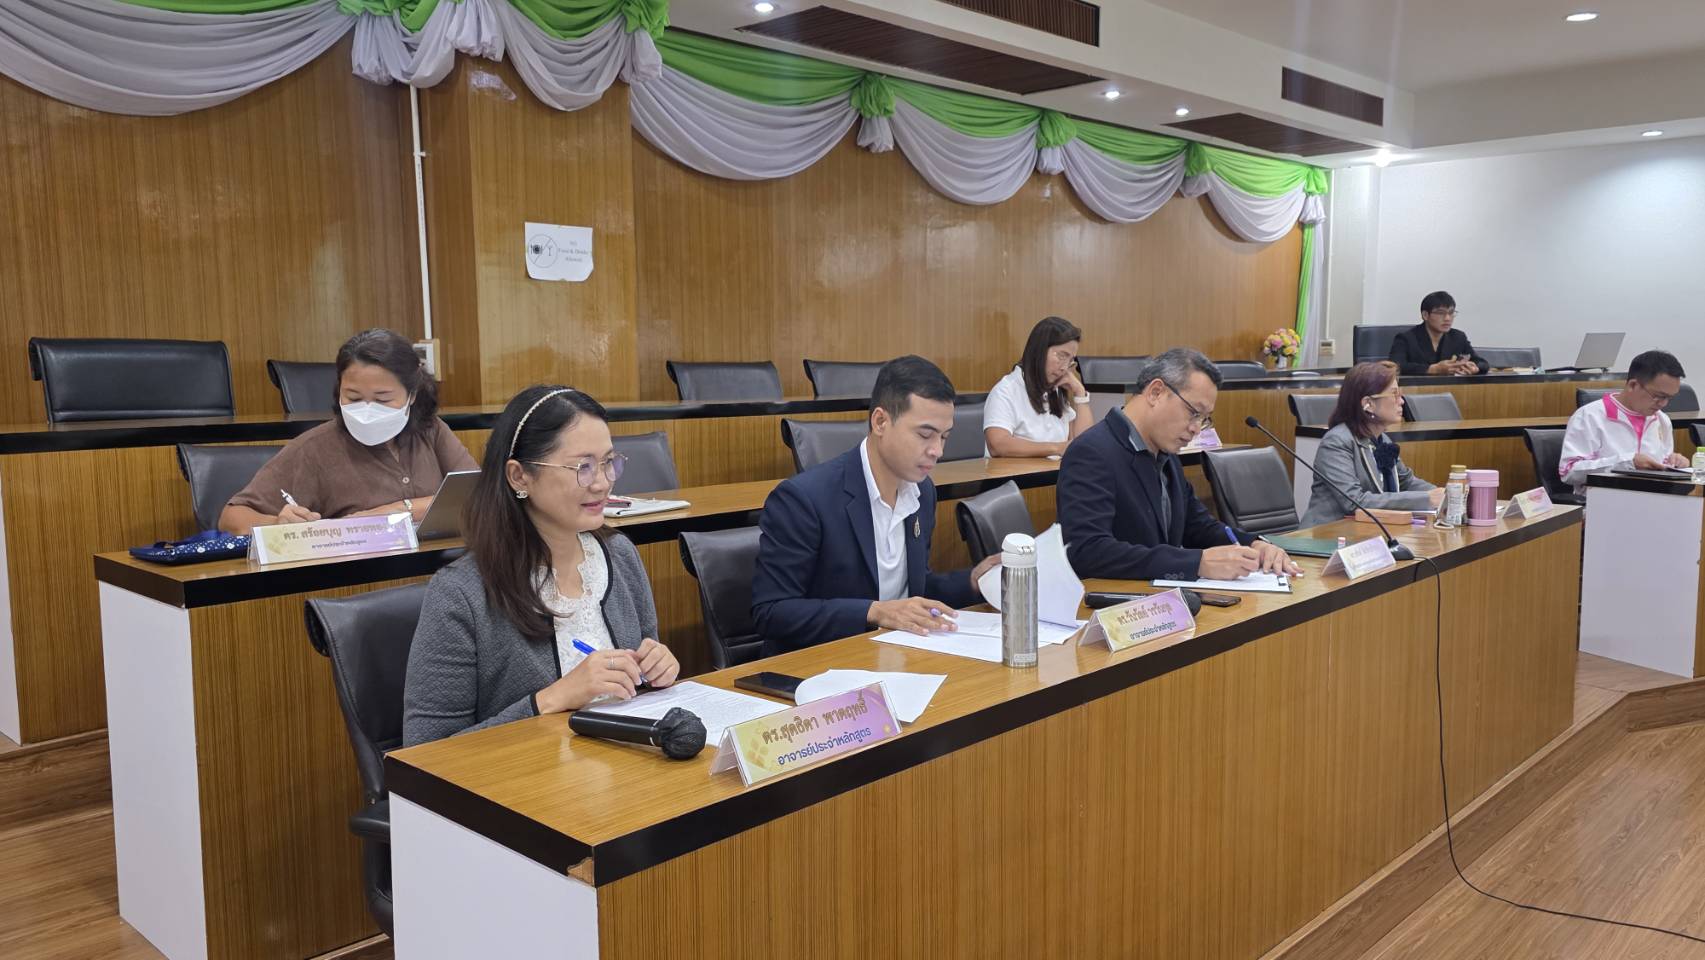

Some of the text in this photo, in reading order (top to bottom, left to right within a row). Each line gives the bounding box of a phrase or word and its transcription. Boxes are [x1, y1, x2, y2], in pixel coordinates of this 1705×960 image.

[777, 726, 872, 766] อาจารย์ประจำหลักสูตร
